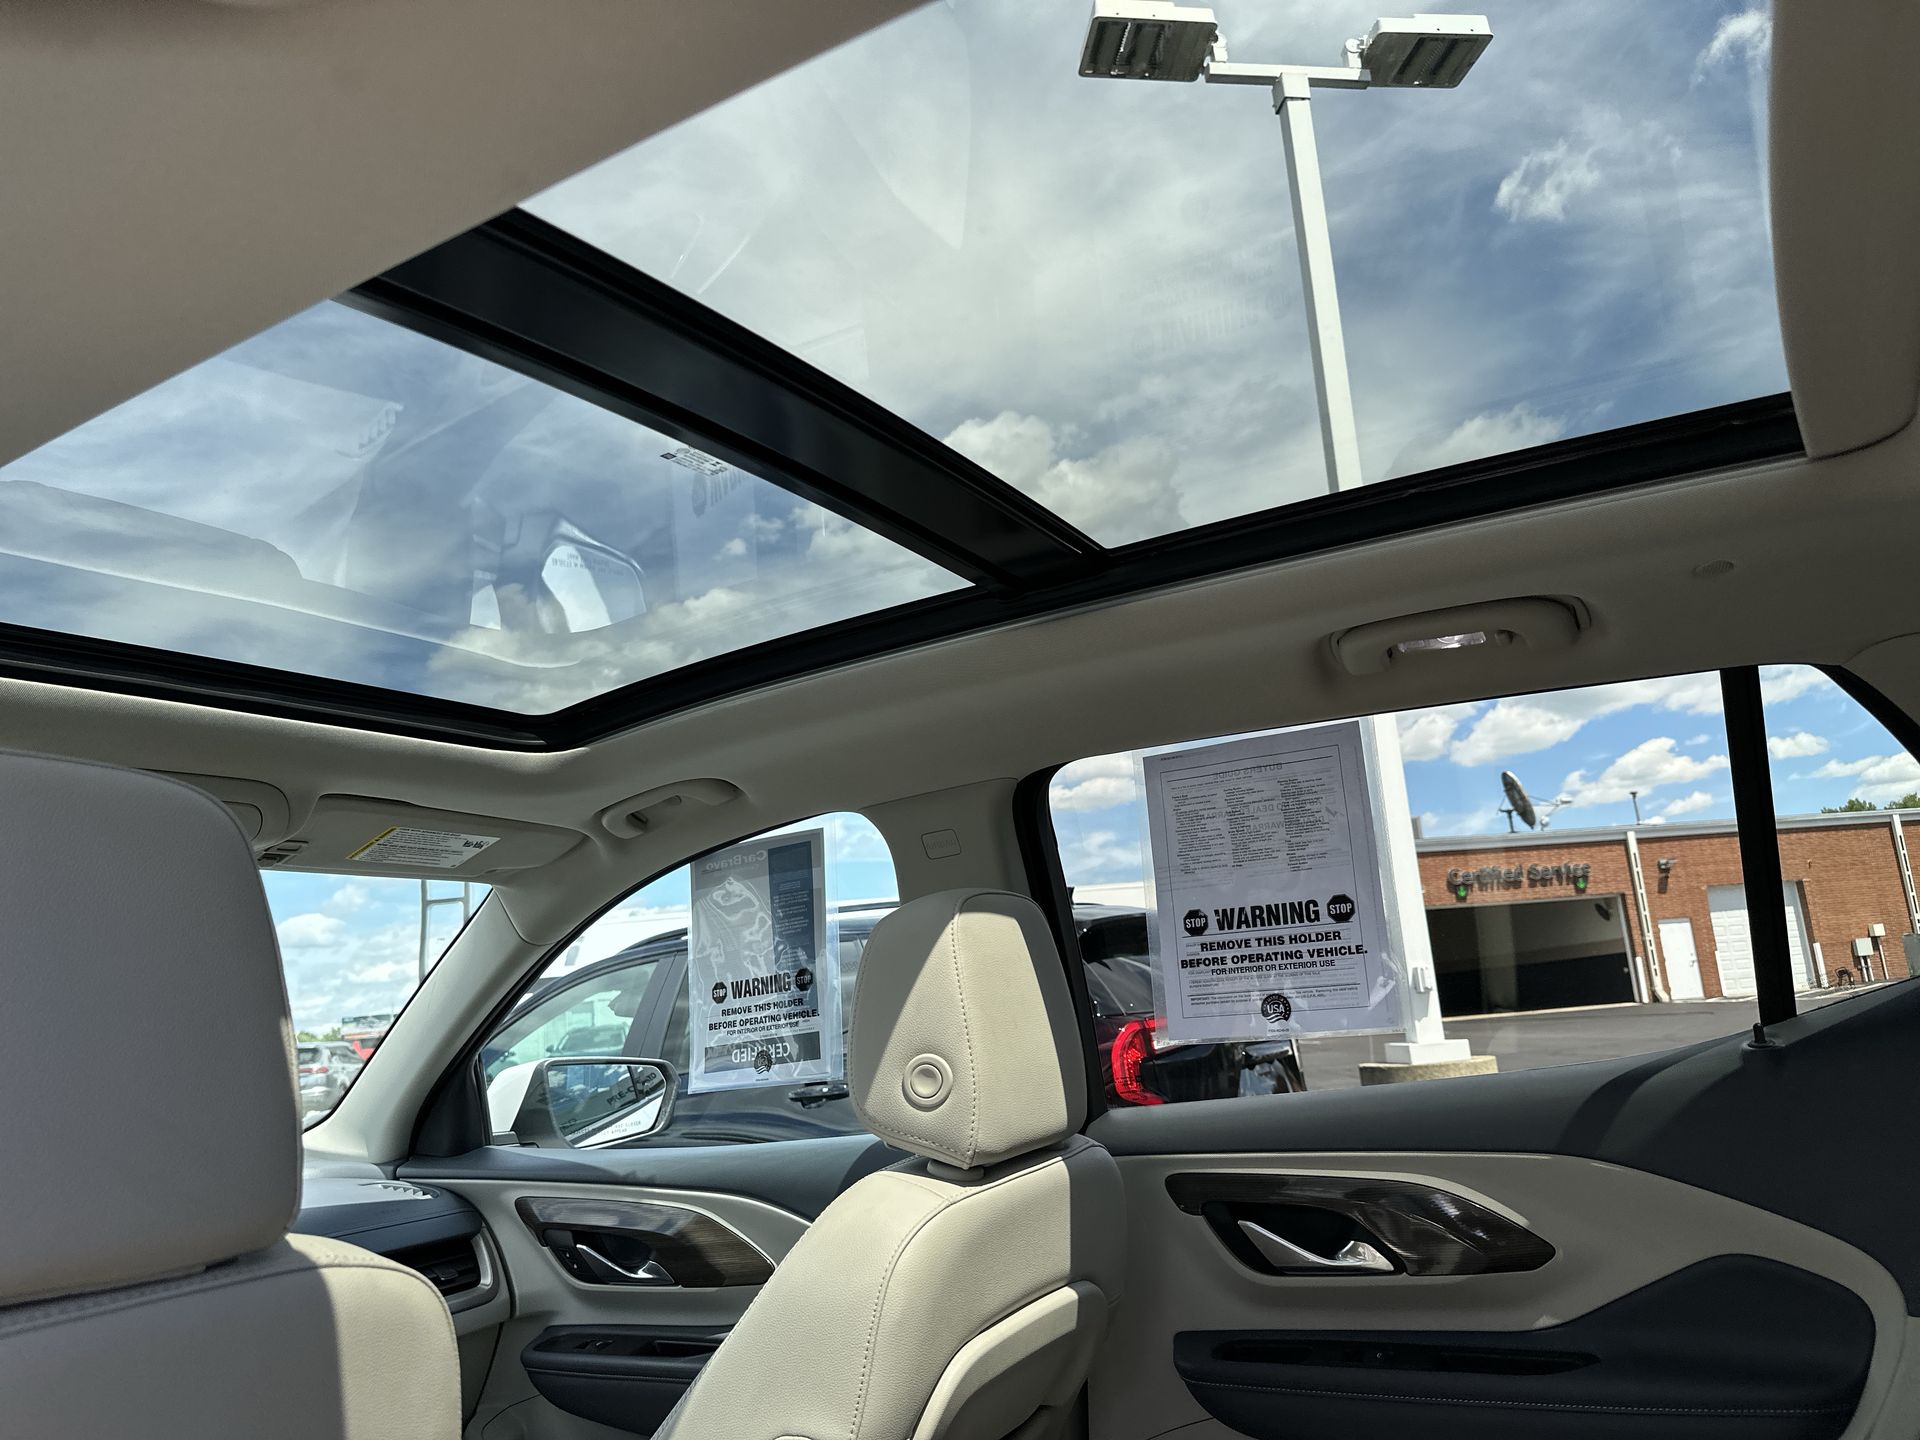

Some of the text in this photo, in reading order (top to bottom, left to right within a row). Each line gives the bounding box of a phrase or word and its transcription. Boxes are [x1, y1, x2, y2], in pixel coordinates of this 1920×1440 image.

[1448, 862, 1591, 886] Certified Service
[1214, 899, 1320, 931] WARNING
[1329, 902, 1352, 915] STOP
[1185, 917, 1206, 929] STOP
[1200, 938, 1251, 952] REMOVE
[1255, 935, 1285, 948] THIS
[1289, 931, 1342, 945] HOLDER
[1180, 944, 1368, 969] BEFORE OPERATING VEHICLE.
[1211, 968, 1227, 976] FOR
[1228, 964, 1264, 975] INTERIOR
[1265, 963, 1277, 972] OR
[1278, 961, 1318, 971] EXTERIOR
[1319, 959, 1336, 968] USE
[730, 972, 791, 999] WARNING
[796, 976, 811, 985] STOP
[713, 988, 726, 998] STOP
[721, 998, 804, 1017] REMOVE THIS HOLDER
[1267, 1004, 1285, 1014] USA
[709, 1009, 820, 1031] BEFORE OPERATING VEHICLE.
[737, 1026, 758, 1035] INTERIOR
